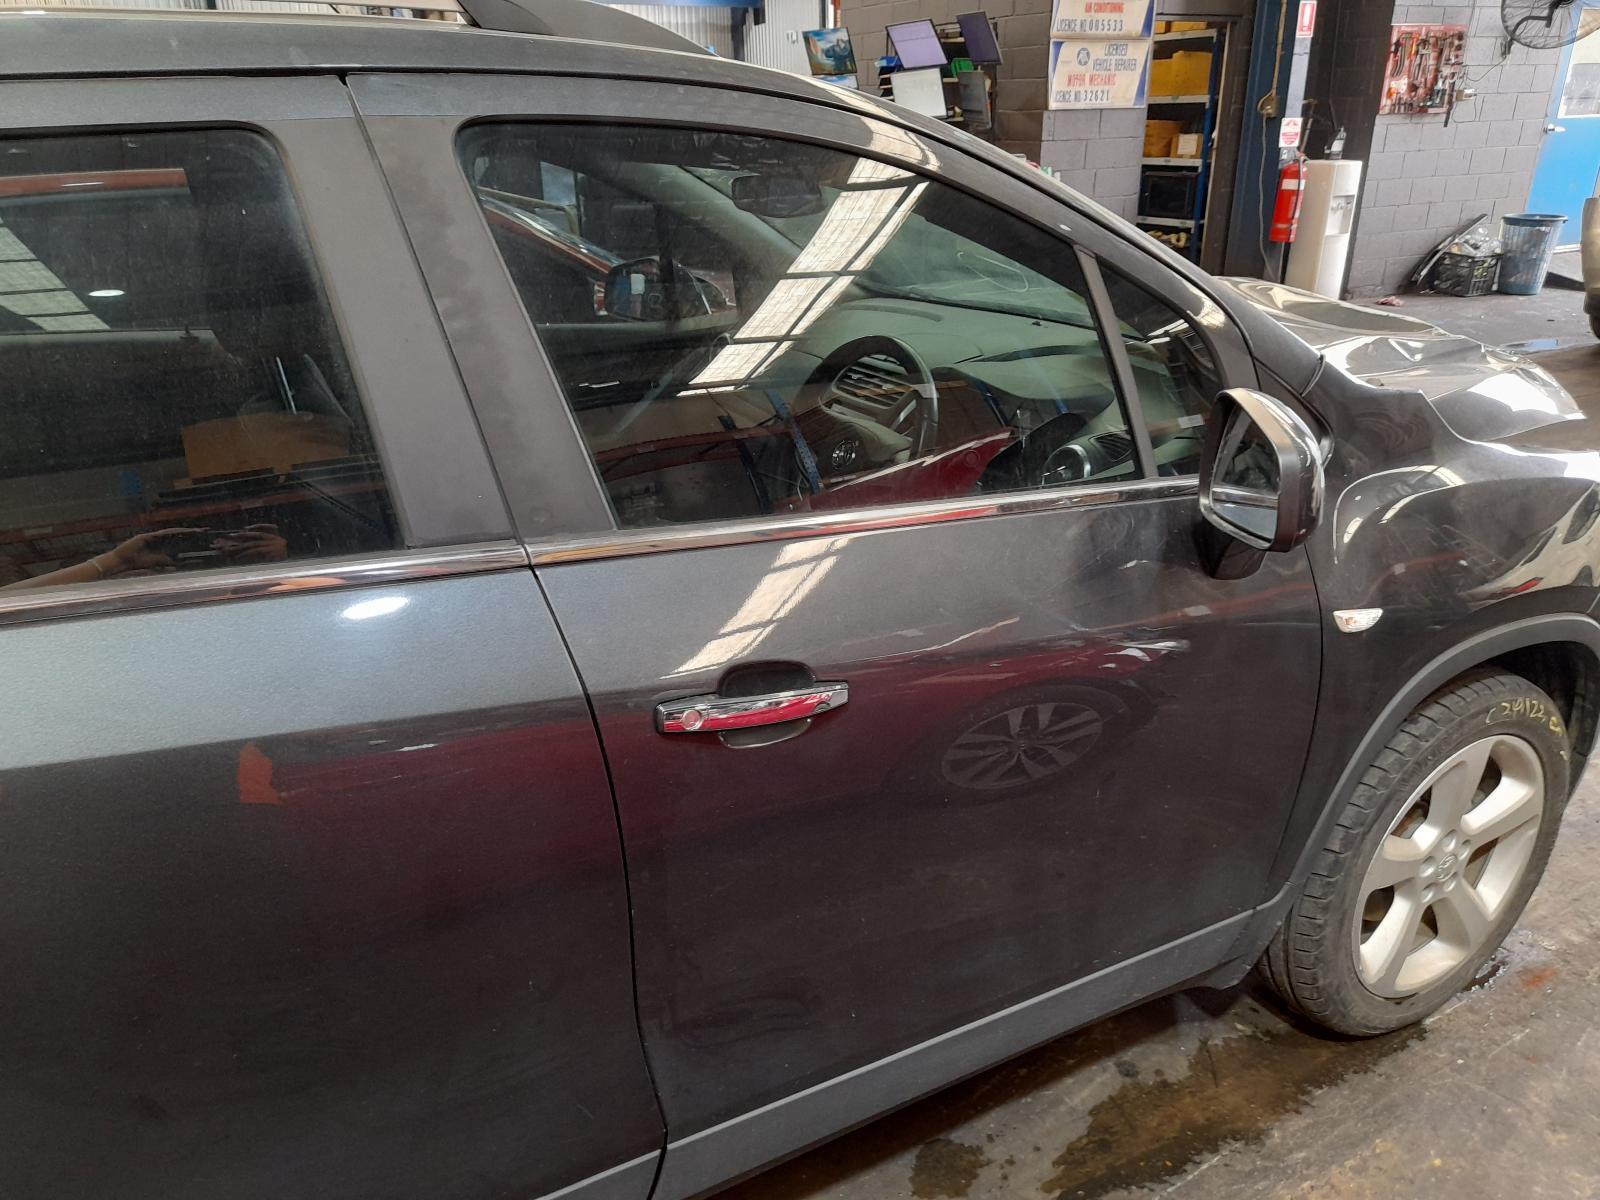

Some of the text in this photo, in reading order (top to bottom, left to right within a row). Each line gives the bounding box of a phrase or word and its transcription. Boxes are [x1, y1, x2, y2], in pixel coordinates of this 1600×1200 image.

[1093, 58, 1137, 72] VEHICLE REPAIRER
[1067, 73, 1117, 87] MOTOR MECHANIC
[1083, 89, 1109, 102] 32621
